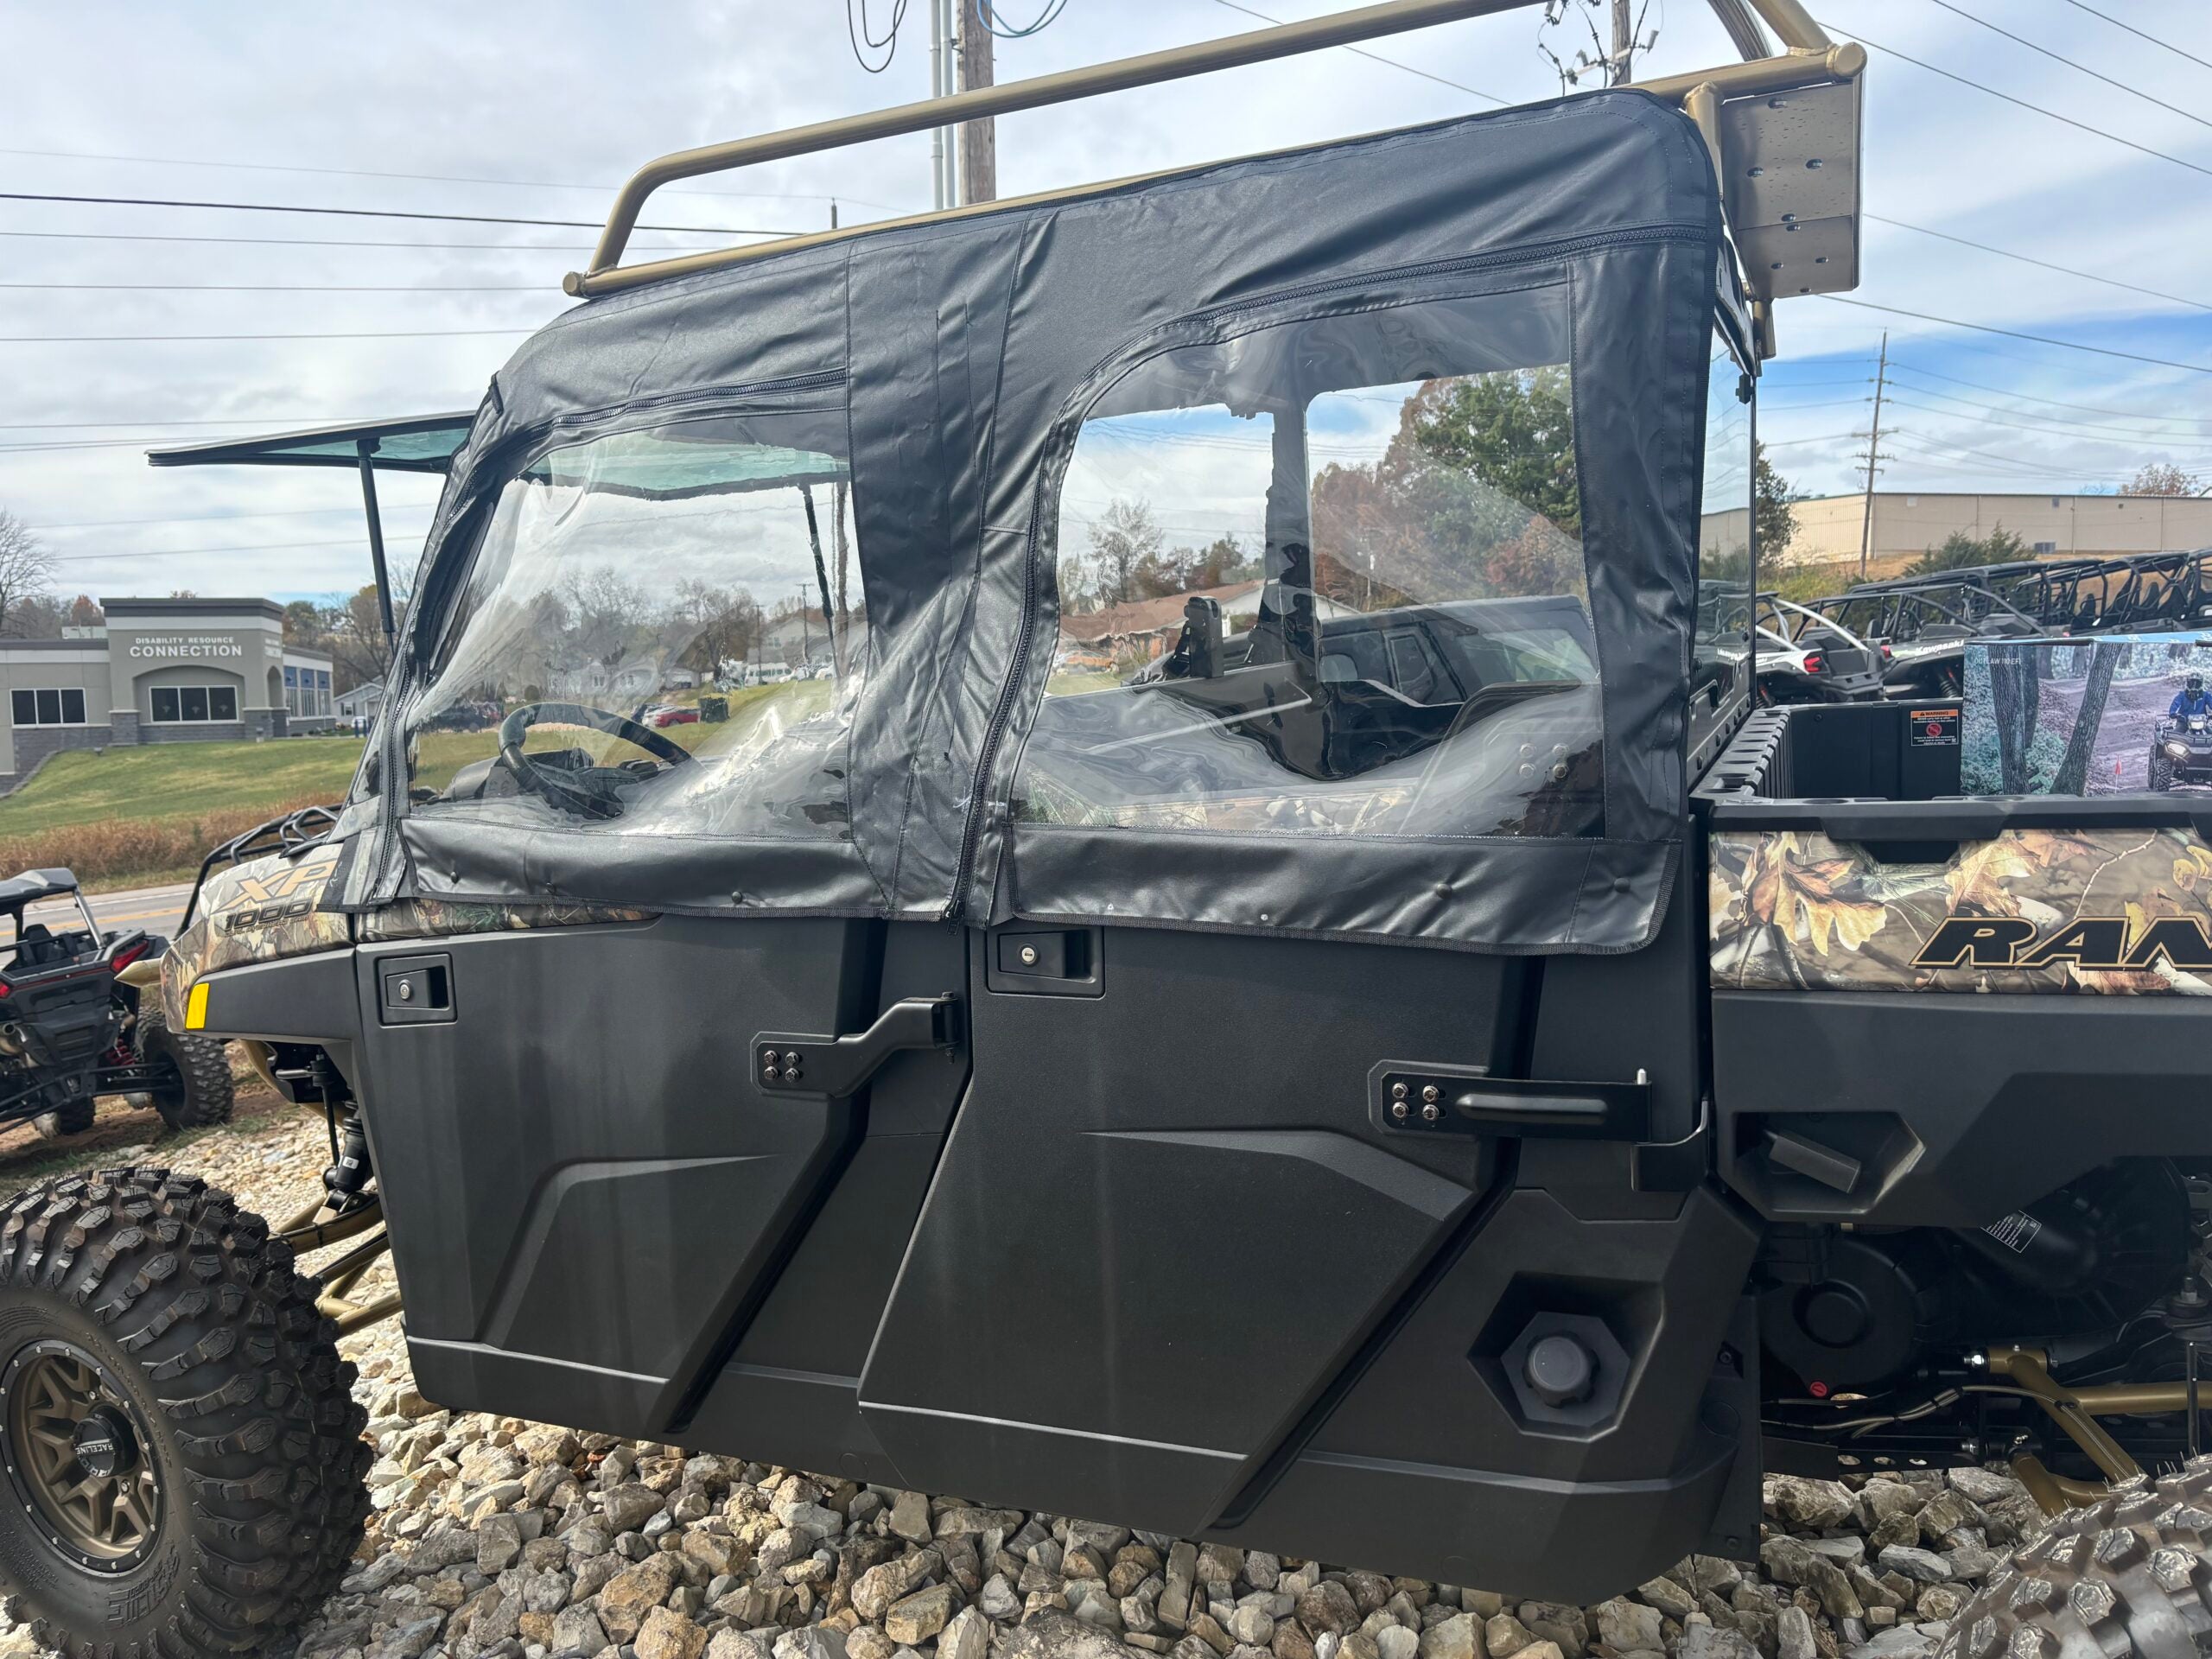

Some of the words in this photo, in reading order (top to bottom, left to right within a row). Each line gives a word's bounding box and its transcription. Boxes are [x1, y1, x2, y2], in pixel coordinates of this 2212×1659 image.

[130, 645, 242, 658] CONNECTION
[1916, 639, 1964, 656] Kawasaki
[212, 858, 338, 914] XP
[224, 897, 314, 932] 1000
[74, 1442, 114, 1455] RACELINE
